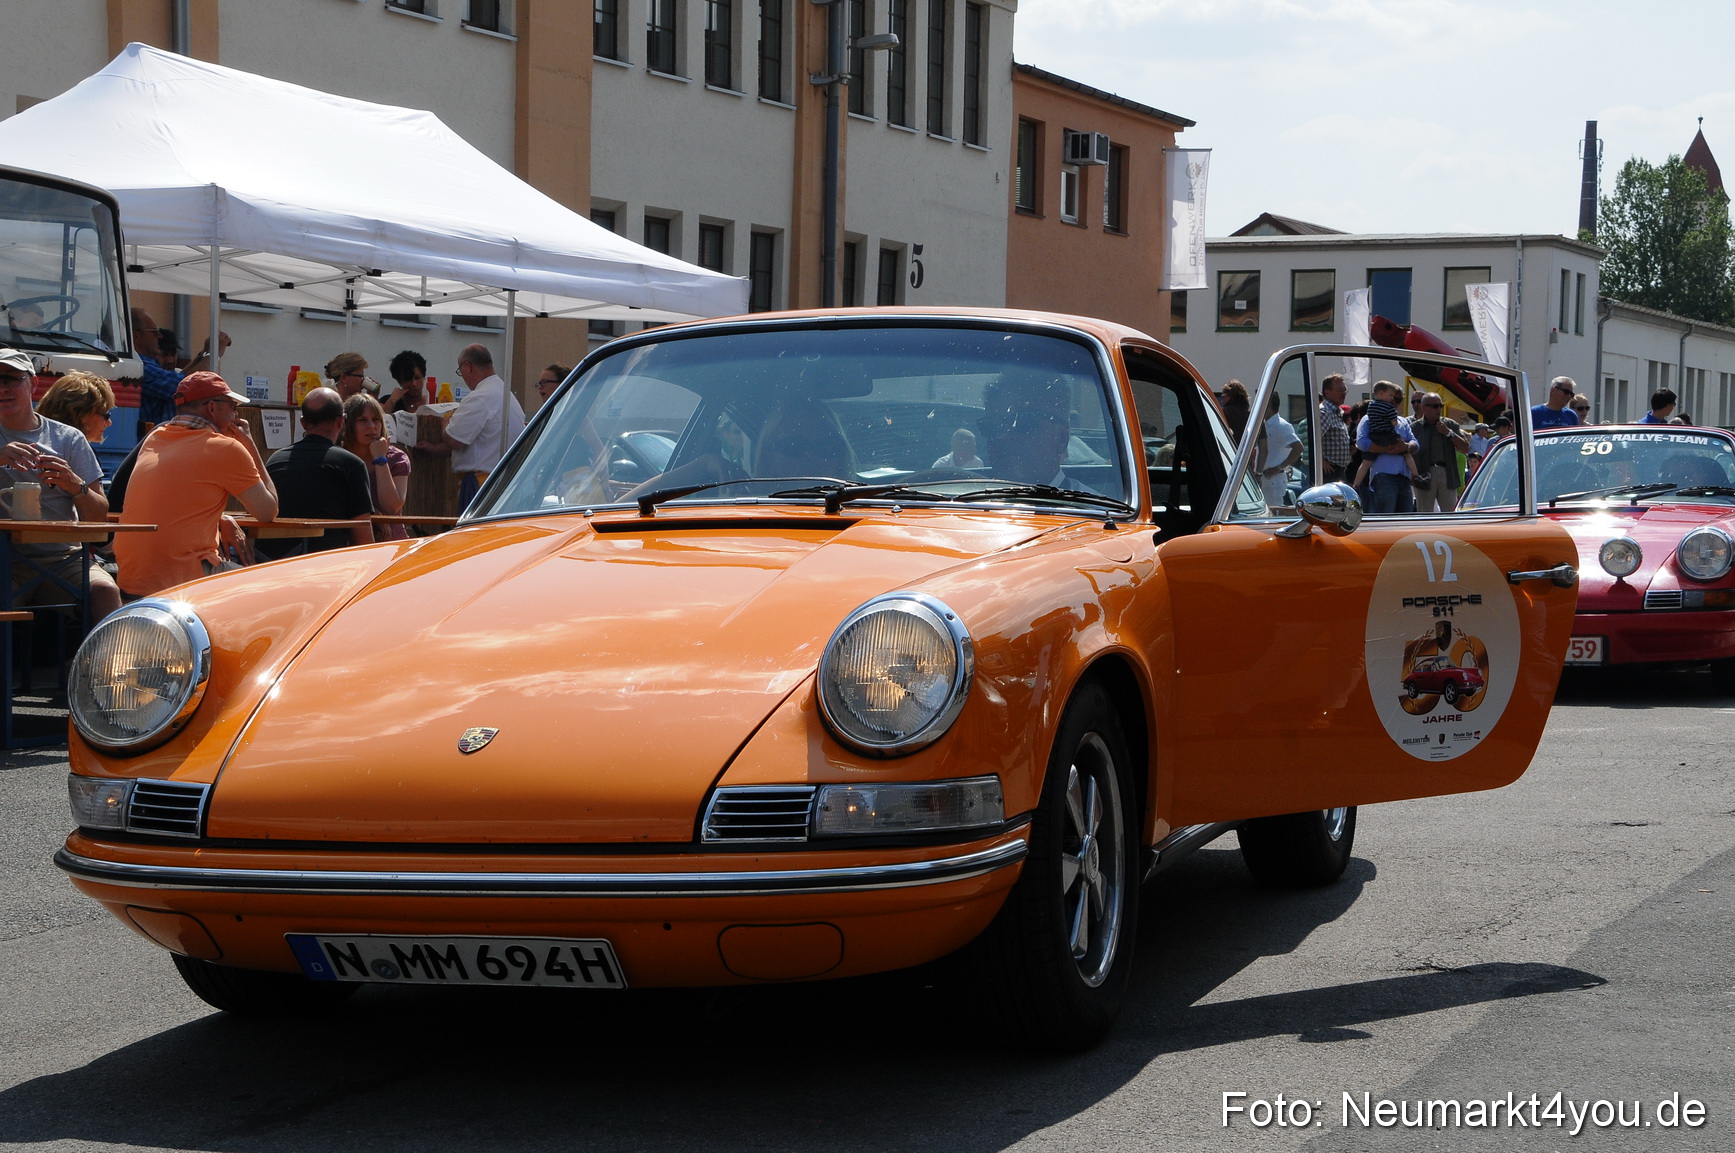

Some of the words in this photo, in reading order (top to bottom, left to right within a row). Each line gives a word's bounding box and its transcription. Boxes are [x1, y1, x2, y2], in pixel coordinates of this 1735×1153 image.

[1188, 181, 1197, 267] OFENWERK
[910, 242, 924, 289] 5
[1560, 435, 1610, 445] Historic
[1612, 433, 1709, 445] RALLYE-TEAM
[1580, 441, 1613, 456] 50
[1415, 540, 1458, 583] 12
[1402, 594, 1482, 608] PORSCHE
[1432, 607, 1454, 618] 911
[1569, 639, 1597, 659] 59
[1422, 713, 1463, 724] JAHRE
[312, 962, 324, 973] D
[324, 941, 371, 977] N
[389, 942, 470, 980] MM
[477, 944, 617, 984] 694H
